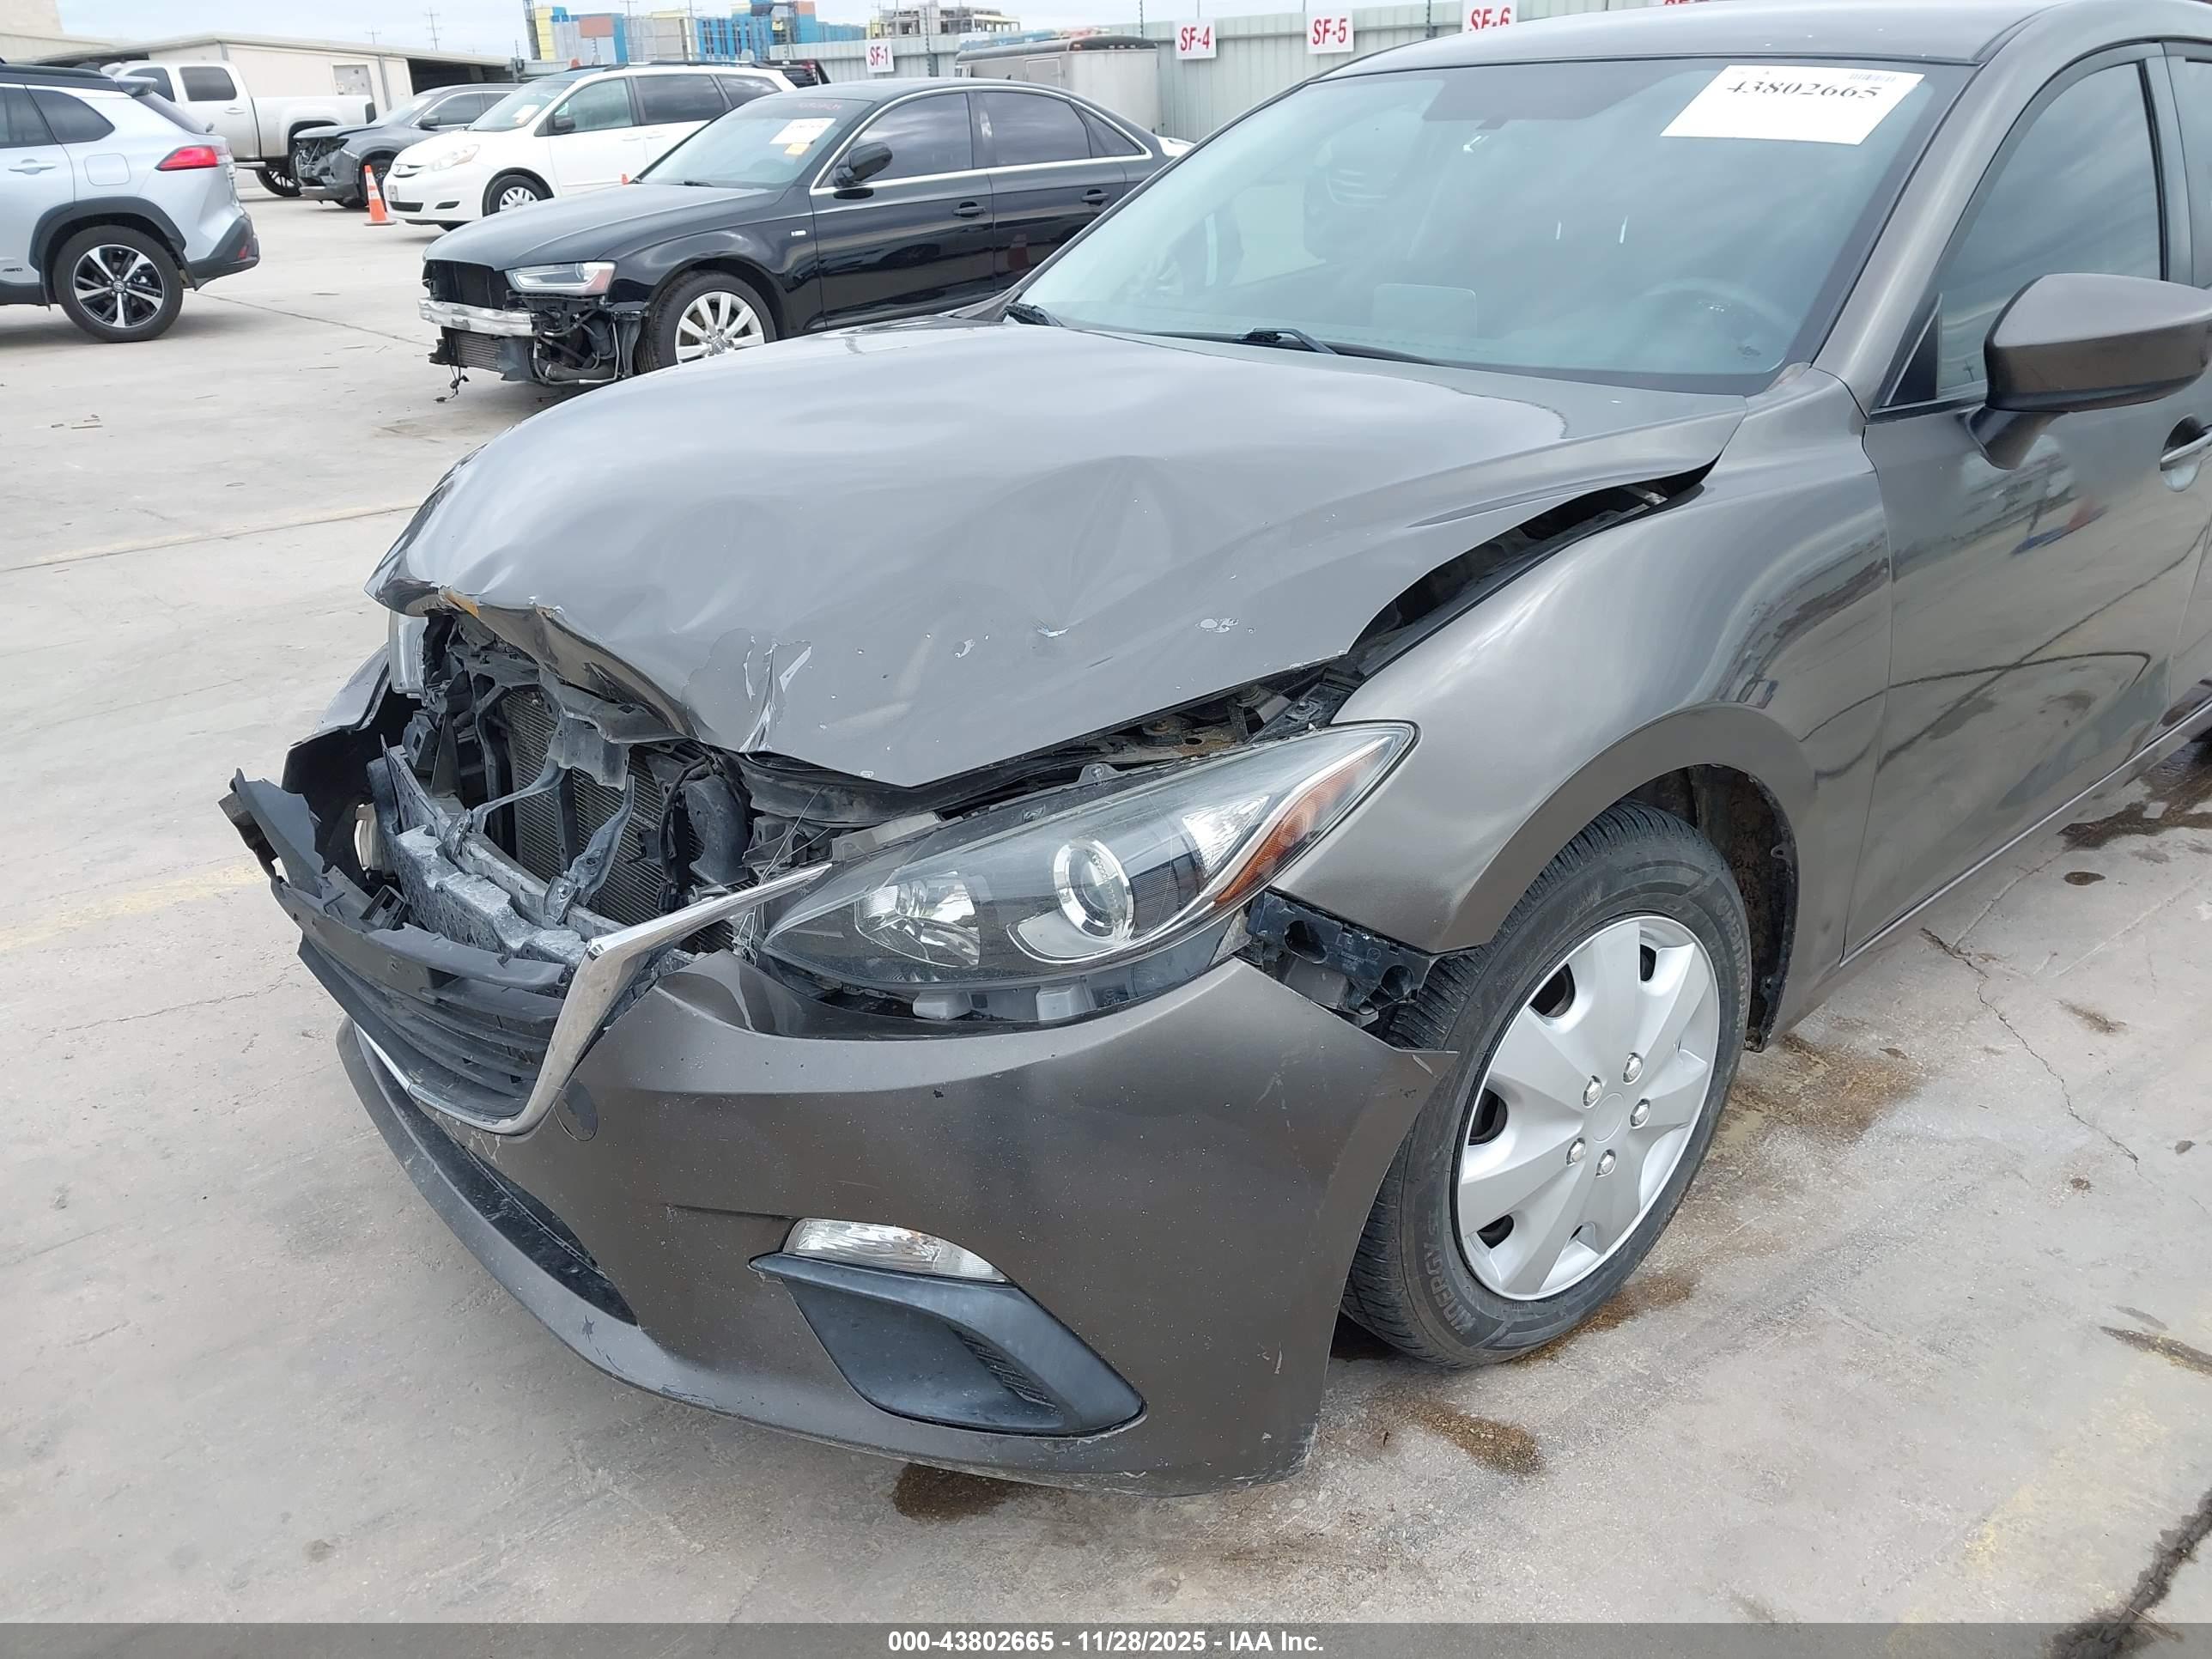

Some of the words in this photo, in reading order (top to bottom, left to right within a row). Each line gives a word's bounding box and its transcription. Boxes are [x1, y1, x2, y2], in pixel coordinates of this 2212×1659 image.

[1180, 26, 1211, 52] SF-4
[1312, 17, 1347, 46] SF-5
[870, 46, 888, 66] SF-1
[1727, 81, 1882, 99] 43802665
